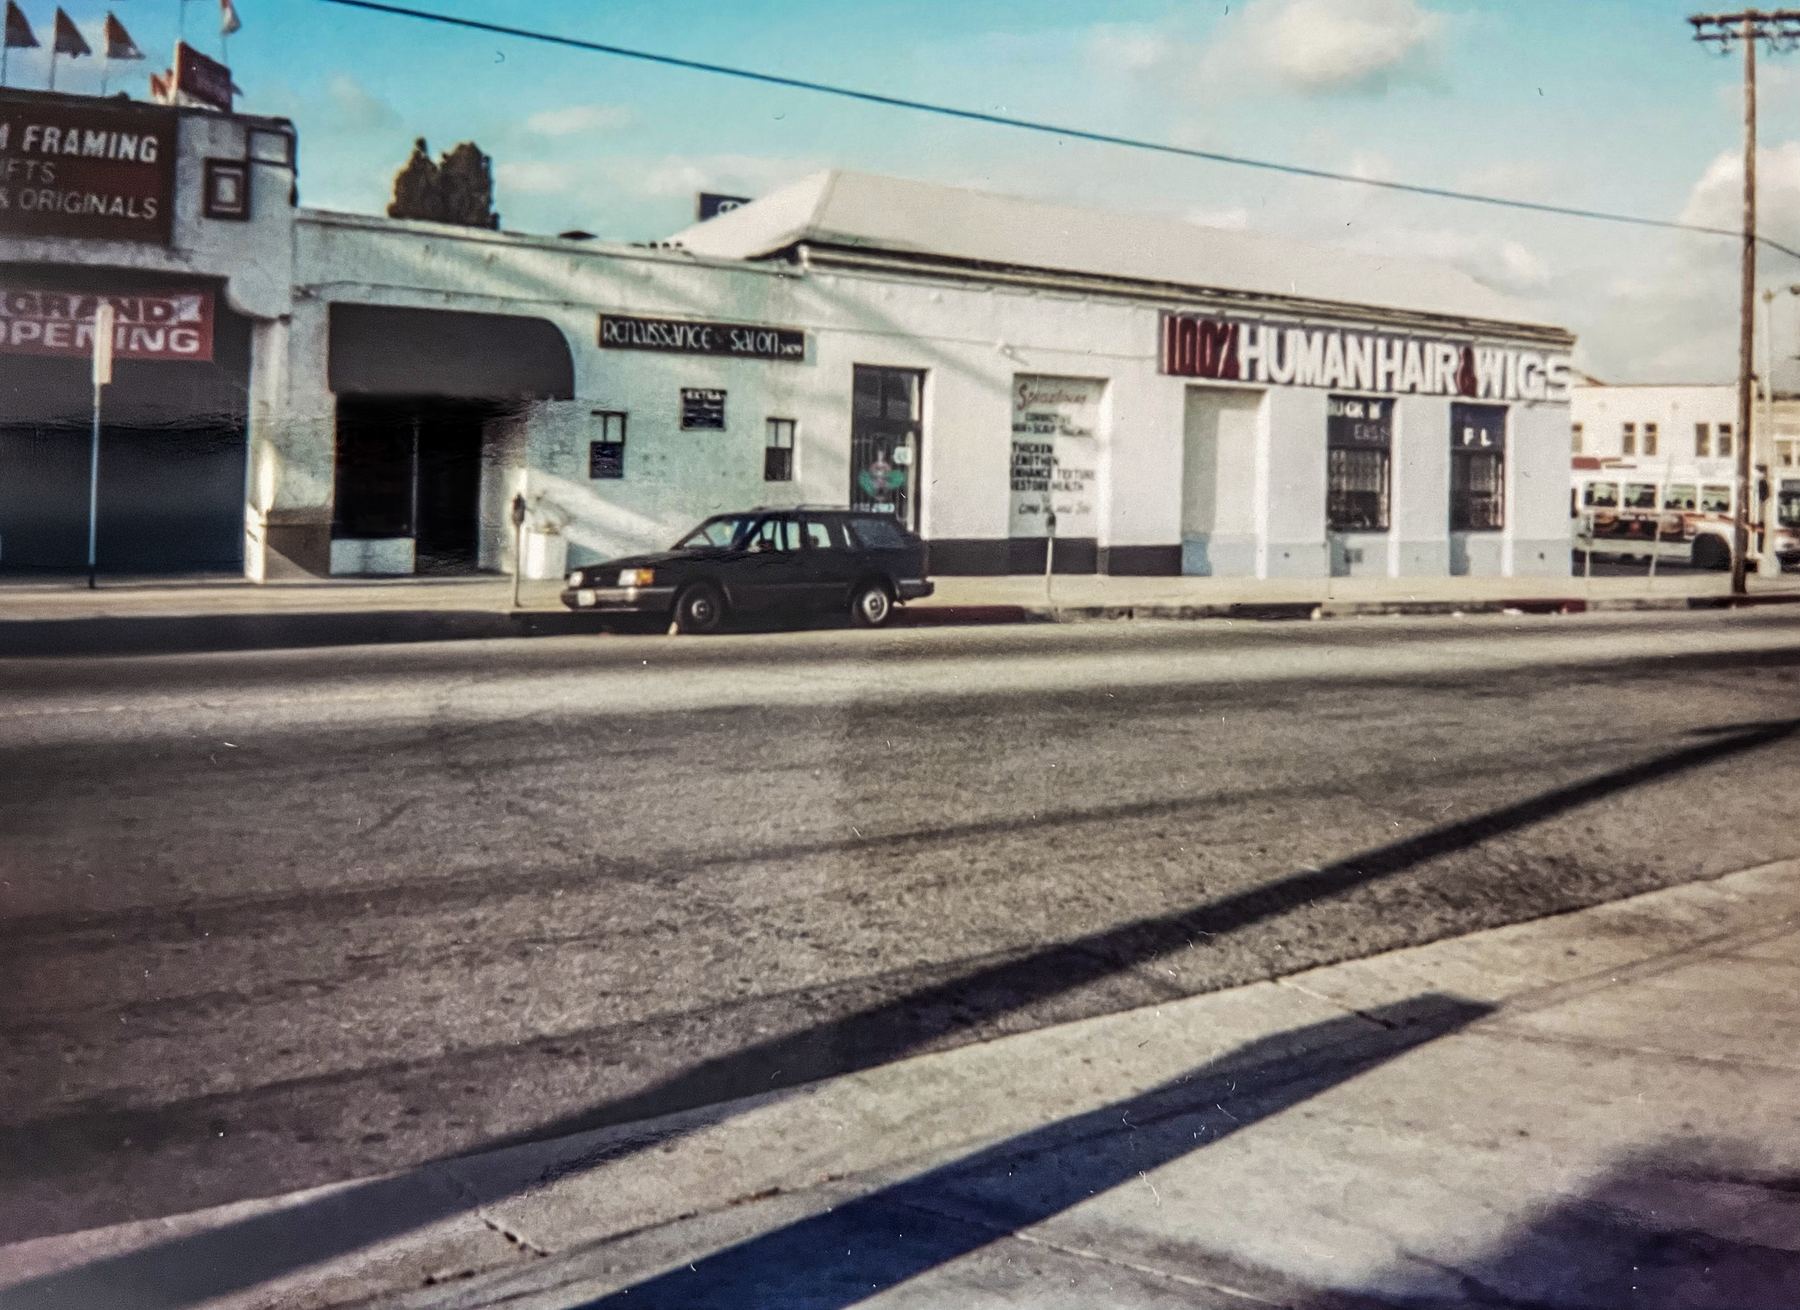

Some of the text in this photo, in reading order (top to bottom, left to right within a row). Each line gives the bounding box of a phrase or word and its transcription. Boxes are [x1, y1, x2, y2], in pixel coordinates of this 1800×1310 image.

[22, 124, 159, 164] FRAMING
[18, 187, 158, 220] ORIGINALS
[0, 319, 200, 353] PENING
[1164, 315, 1240, 379] 100%
[1239, 323, 1374, 390] HUMAN
[1376, 336, 1459, 396] HAIR
[1475, 349, 1571, 401] WIGS
